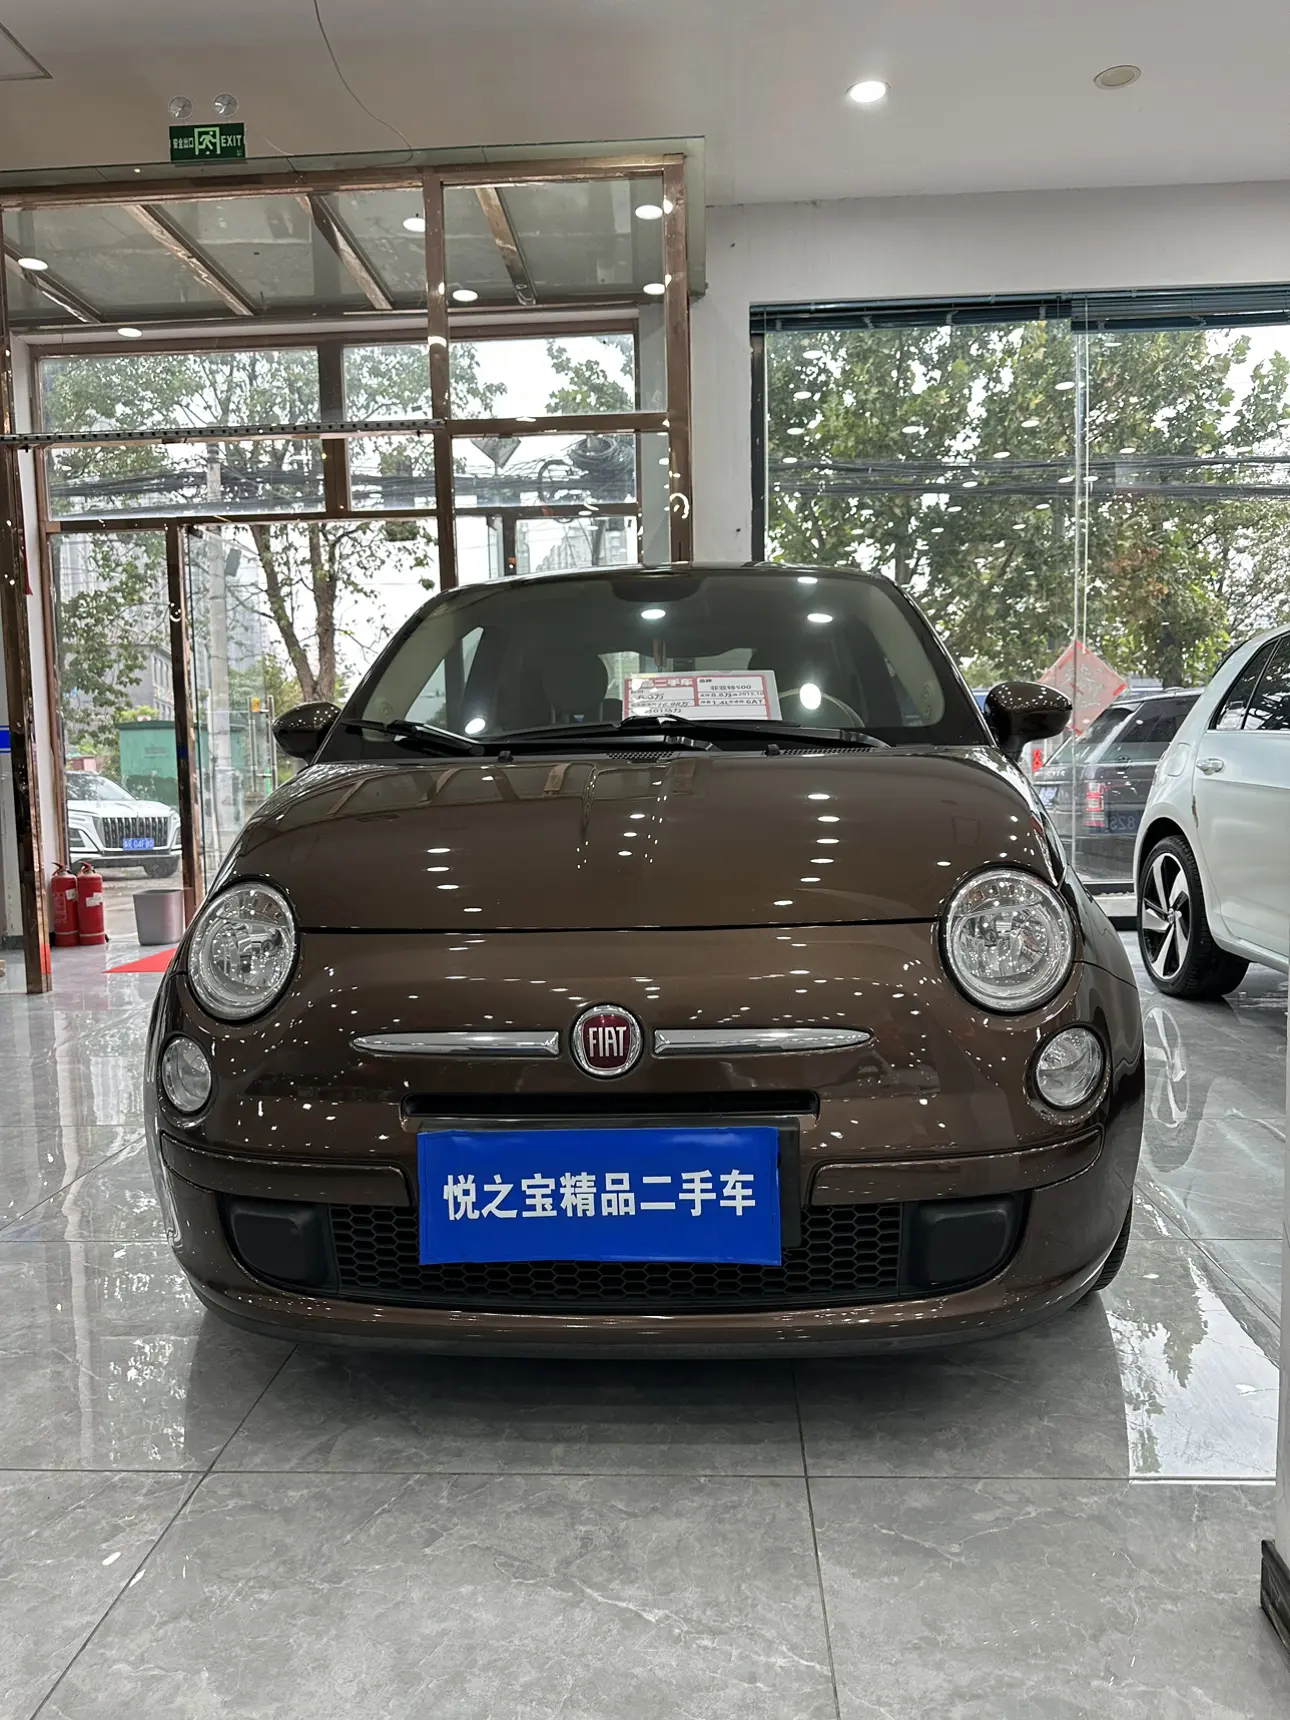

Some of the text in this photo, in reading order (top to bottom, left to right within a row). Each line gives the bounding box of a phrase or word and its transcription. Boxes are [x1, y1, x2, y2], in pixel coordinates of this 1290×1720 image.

[221, 135, 242, 147] EXIT
[588, 1026, 627, 1057] FIAT
[443, 1169, 756, 1220] 悦之宝精品二手车
